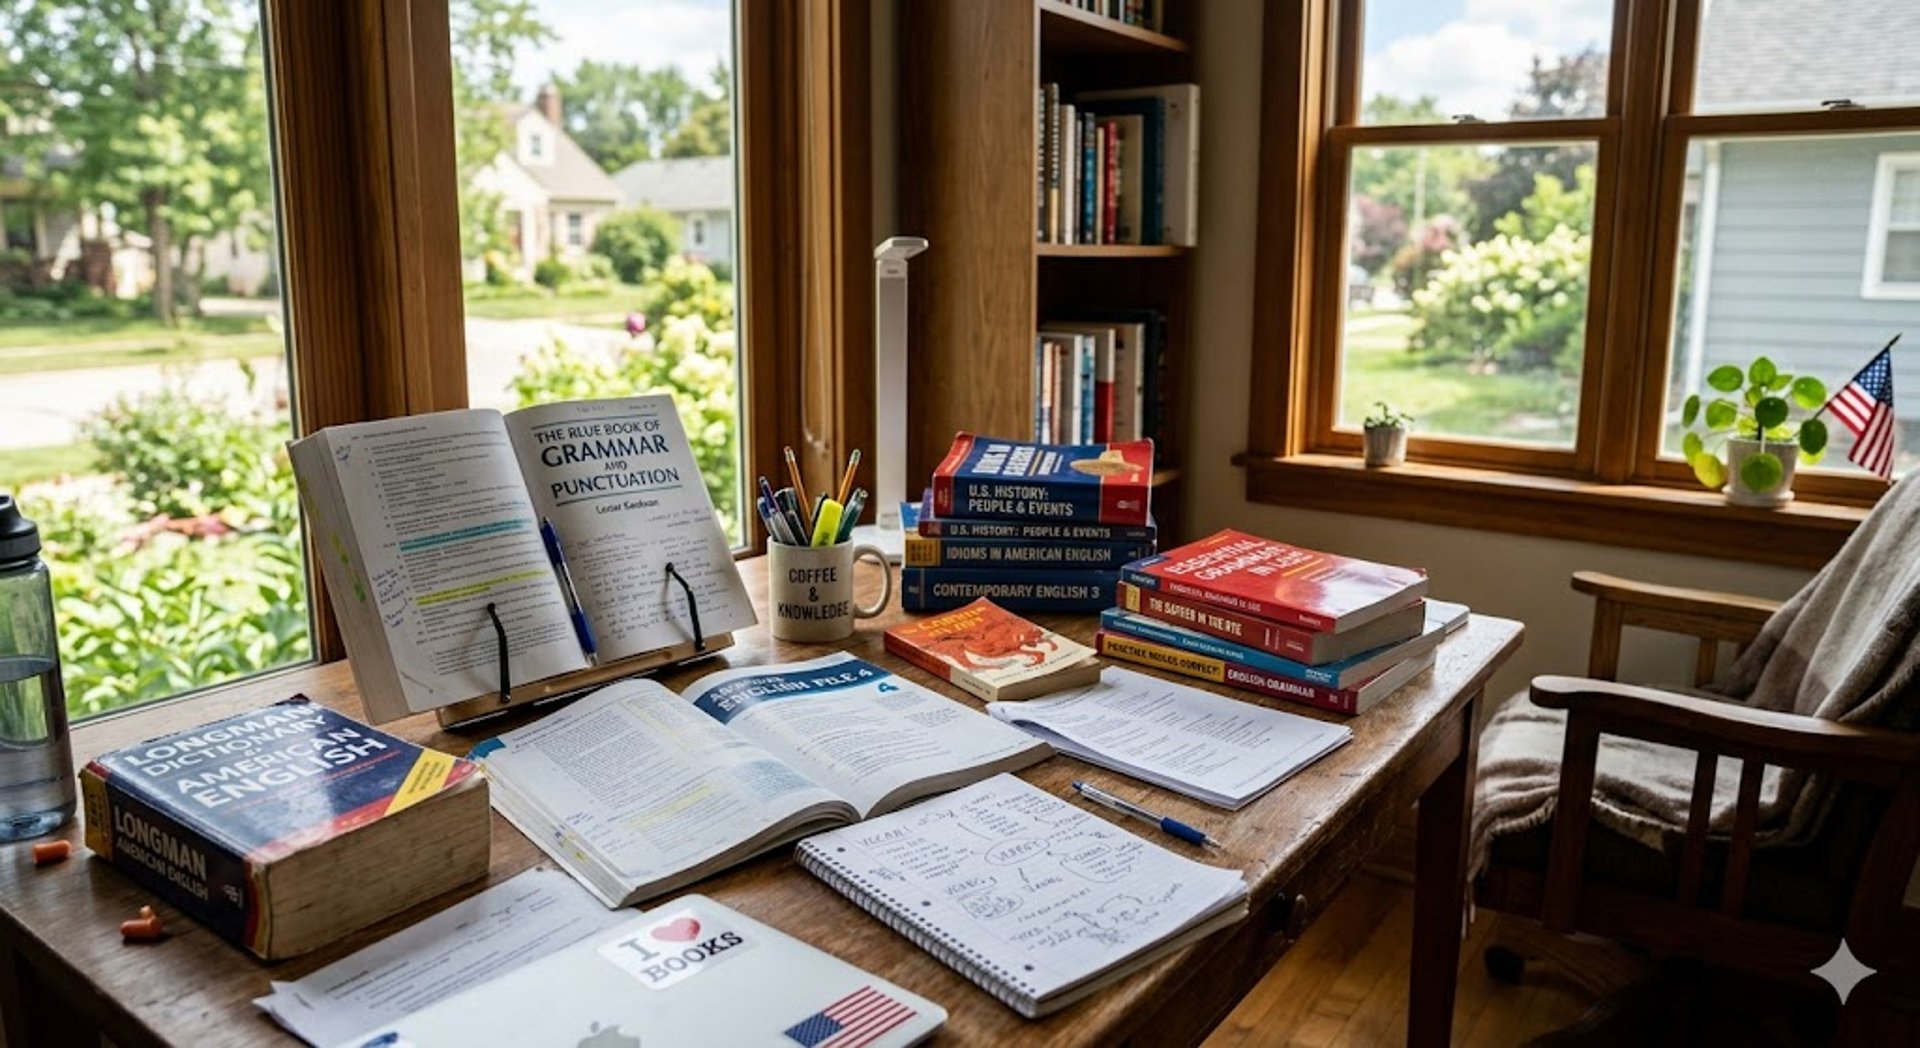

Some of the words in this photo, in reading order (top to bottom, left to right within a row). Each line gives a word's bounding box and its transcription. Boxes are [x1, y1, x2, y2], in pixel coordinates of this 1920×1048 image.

[534, 428, 564, 444] THE
[644, 419, 661, 432] OF
[541, 434, 669, 468] GRAMMAR
[551, 467, 680, 499] PUNCTUATION
[968, 484, 993, 499] U.S.
[994, 485, 1049, 501] HISTORY:
[1015, 502, 1025, 515] &
[1028, 502, 1074, 518] EVENTS
[950, 524, 971, 536] U.S.
[971, 525, 1019, 536] HISTORY:
[1023, 526, 1059, 538] PEOPLE
[1062, 527, 1071, 538] &
[1072, 526, 1112, 539] EVENTS
[946, 547, 987, 560] IDIOMS
[989, 547, 1002, 560] IN
[1003, 547, 1062, 561] AMERICAN
[789, 566, 837, 584] COFFEE
[809, 586, 819, 602] &
[932, 583, 1033, 598] CONTEMPORARY
[1035, 584, 1089, 599] ENGLISH
[1090, 585, 1100, 599] 3
[142, 715, 326, 777] DICTIONARY
[176, 728, 361, 794] AMERICAN
[191, 737, 388, 808] ENGLISH
[114, 804, 208, 882] LONGMAN
[618, 937, 660, 962] I
[640, 931, 744, 983] BOOKS
